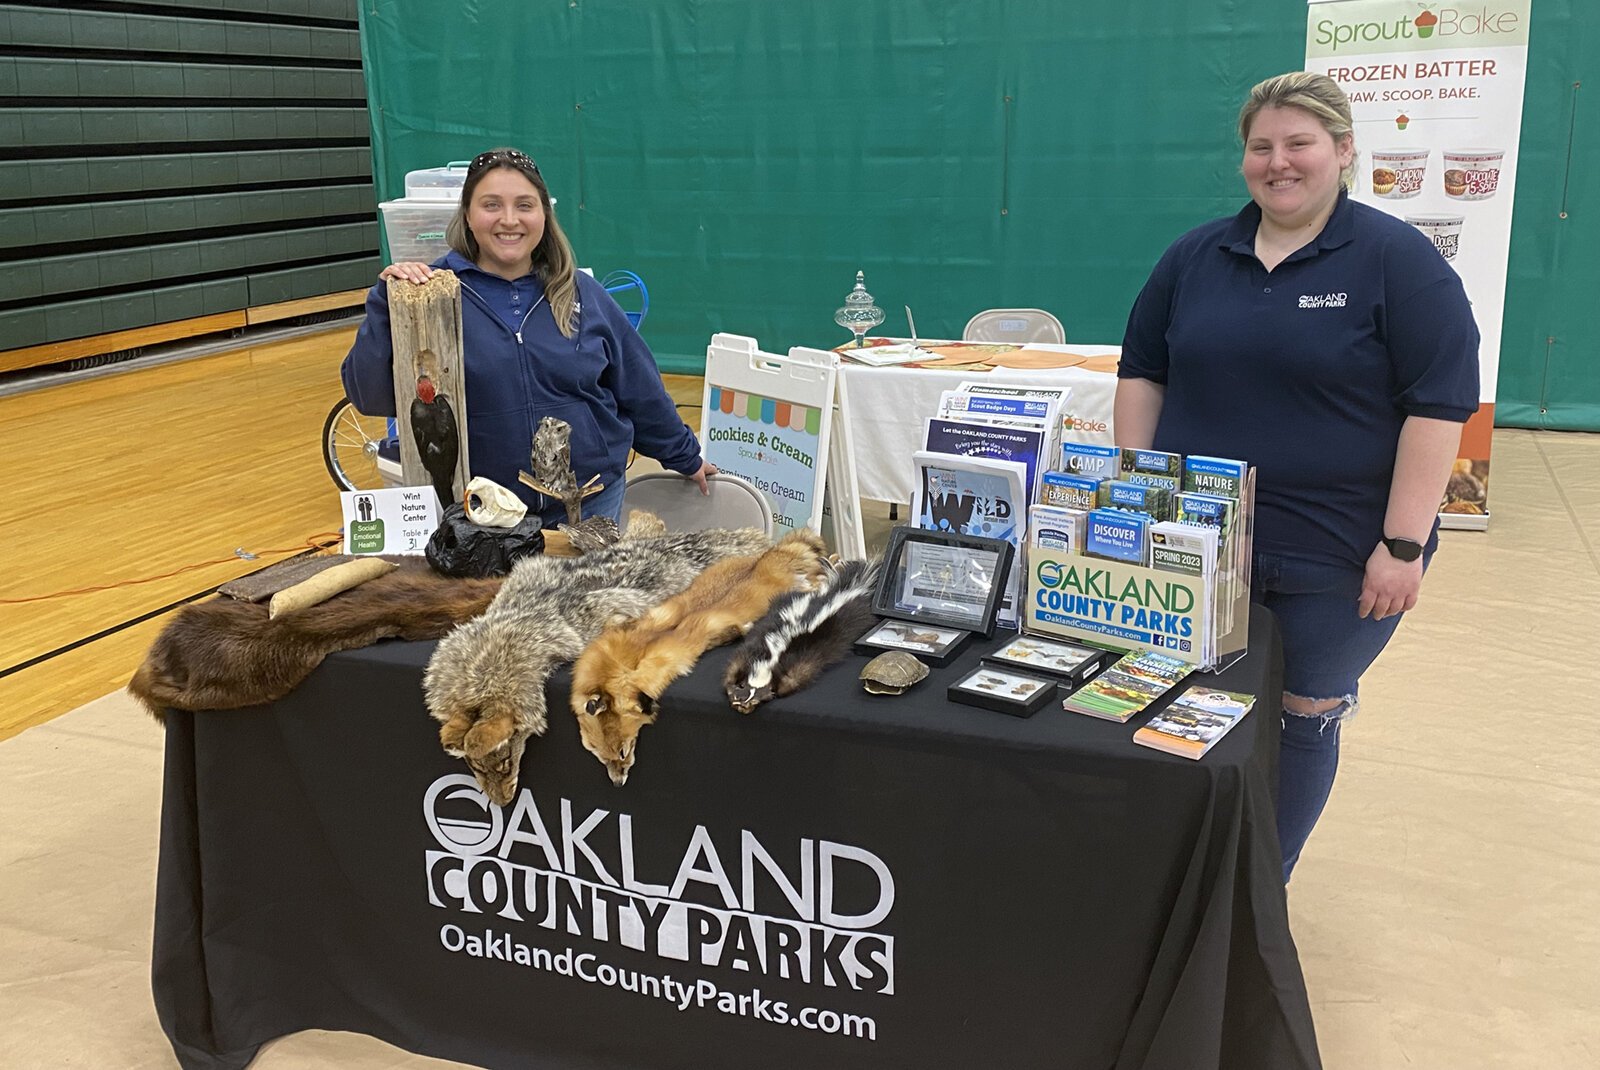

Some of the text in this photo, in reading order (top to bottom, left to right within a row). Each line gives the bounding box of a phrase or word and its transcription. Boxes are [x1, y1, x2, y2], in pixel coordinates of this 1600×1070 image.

[1316, 6, 1519, 50] Sprout Bake
[1327, 59, 1497, 84] FROZEN BATTER
[1347, 87, 1481, 103] HAW. SCOOP. BAKE.
[1395, 168, 1426, 184] PUMPKIN
[1401, 180, 1421, 192] SPICE
[1469, 181, 1498, 194] 5-SPICE
[1434, 234, 1459, 248] DOUBLE
[1298, 292, 1348, 303] OAKLAND
[1298, 300, 1347, 309] COUNTY PARKS
[971, 386, 1019, 395] Homeschool
[971, 402, 985, 410] Scout
[986, 403, 1003, 412] Badge
[1003, 405, 1017, 413] Days
[1074, 418, 1107, 433] Bake
[962, 430, 988, 438] OAKLAND
[708, 426, 813, 470] Cookies & Cream
[1070, 456, 1105, 472] CAMP
[1138, 454, 1166, 462] OAKLAND
[754, 476, 769, 492] Ice
[771, 481, 806, 503] Cream
[1130, 474, 1174, 490] DOG PARKS
[1195, 474, 1233, 490] NATURE
[1049, 490, 1090, 506] EXPERIENCE
[1113, 488, 1143, 498] OAKLAND
[401, 504, 426, 512] Nature
[1184, 500, 1216, 509] OAKLAND
[402, 514, 427, 522] Center
[772, 512, 794, 528] eam
[353, 532, 382, 541] Emotional
[402, 530, 422, 538] Table
[1094, 524, 1136, 541] DISCOVER
[408, 538, 418, 550] 31
[1094, 536, 1134, 548] Where You Live
[1154, 550, 1201, 567] SPRING 2023
[1036, 559, 1195, 614] OAKLAND
[1036, 588, 1193, 638] COUNTY PARKS
[1044, 613, 1142, 641] OaklandCountyParks.com
[423, 773, 896, 929] OAKLAND
[425, 853, 894, 996] COUNTY PARKS
[439, 923, 877, 1041] OaklandCountyParks.com
